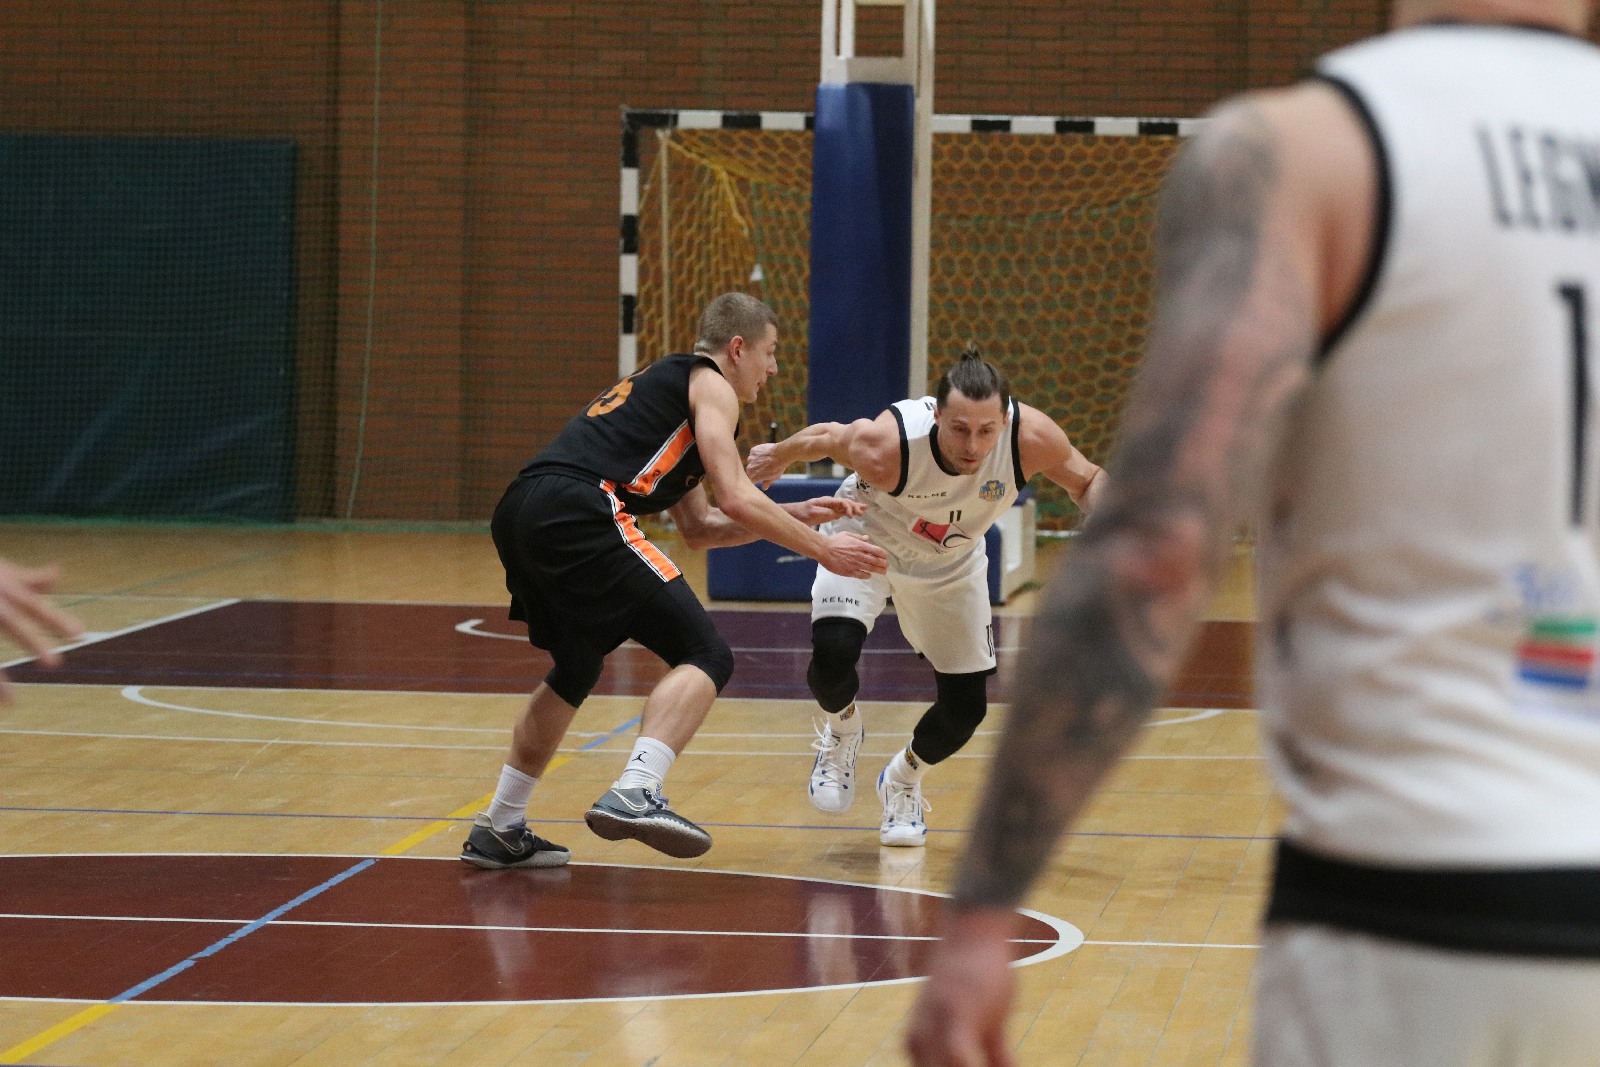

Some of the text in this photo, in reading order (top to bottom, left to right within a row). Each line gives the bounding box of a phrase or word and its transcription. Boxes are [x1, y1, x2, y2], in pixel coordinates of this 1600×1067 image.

[908, 491, 947, 499] KELME
[949, 510, 962, 523] 11
[822, 596, 861, 606] KELME
